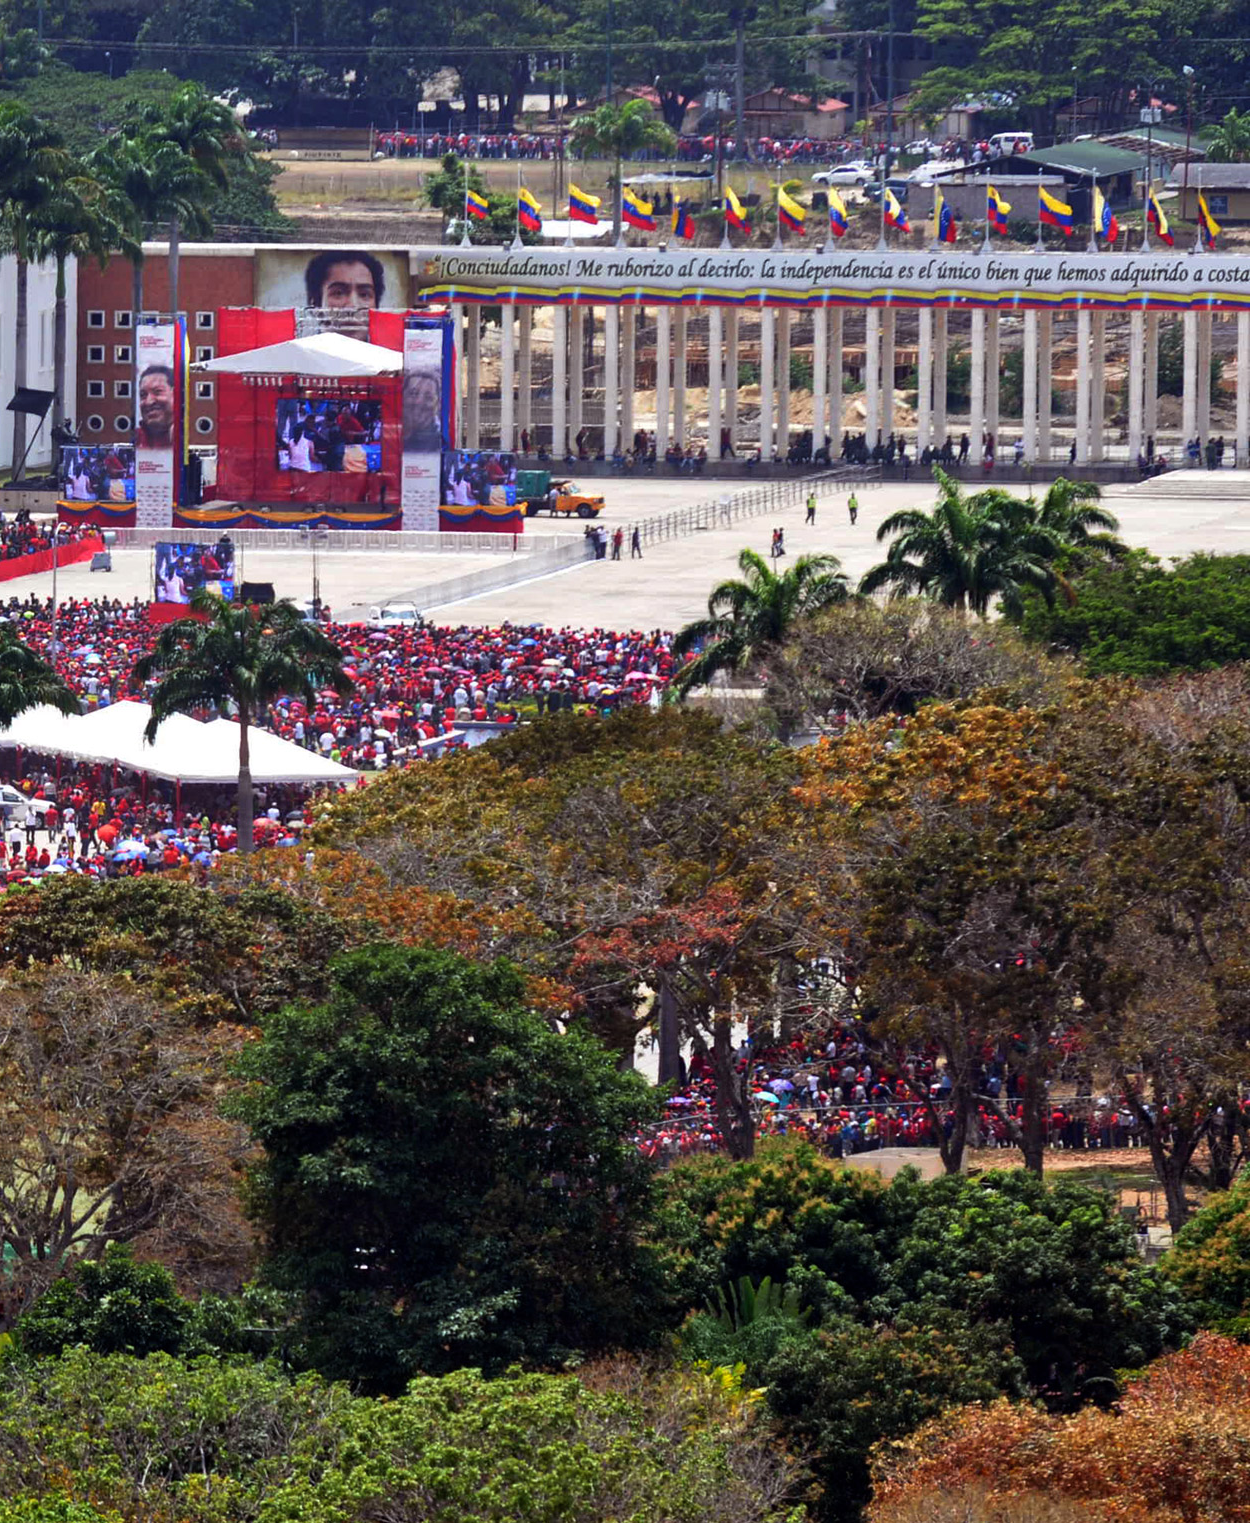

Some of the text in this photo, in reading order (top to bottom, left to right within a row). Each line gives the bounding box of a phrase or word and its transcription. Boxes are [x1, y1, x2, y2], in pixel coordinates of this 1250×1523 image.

[575, 259, 602, 277] Me
[607, 257, 674, 278] ruborizo
[678, 257, 699, 278] al
[698, 258, 755, 278] decirlo:
[761, 258, 776, 279] la
[781, 259, 893, 285] independencia
[898, 265, 915, 279] es
[918, 259, 937, 279] el
[937, 261, 981, 280] único
[986, 260, 1020, 281] bien
[1023, 267, 1052, 287] que
[1057, 260, 1107, 281] hemos
[1110, 261, 1189, 288] adquirido
[1193, 268, 1203, 282] a
[1207, 266, 1249, 282] costa
